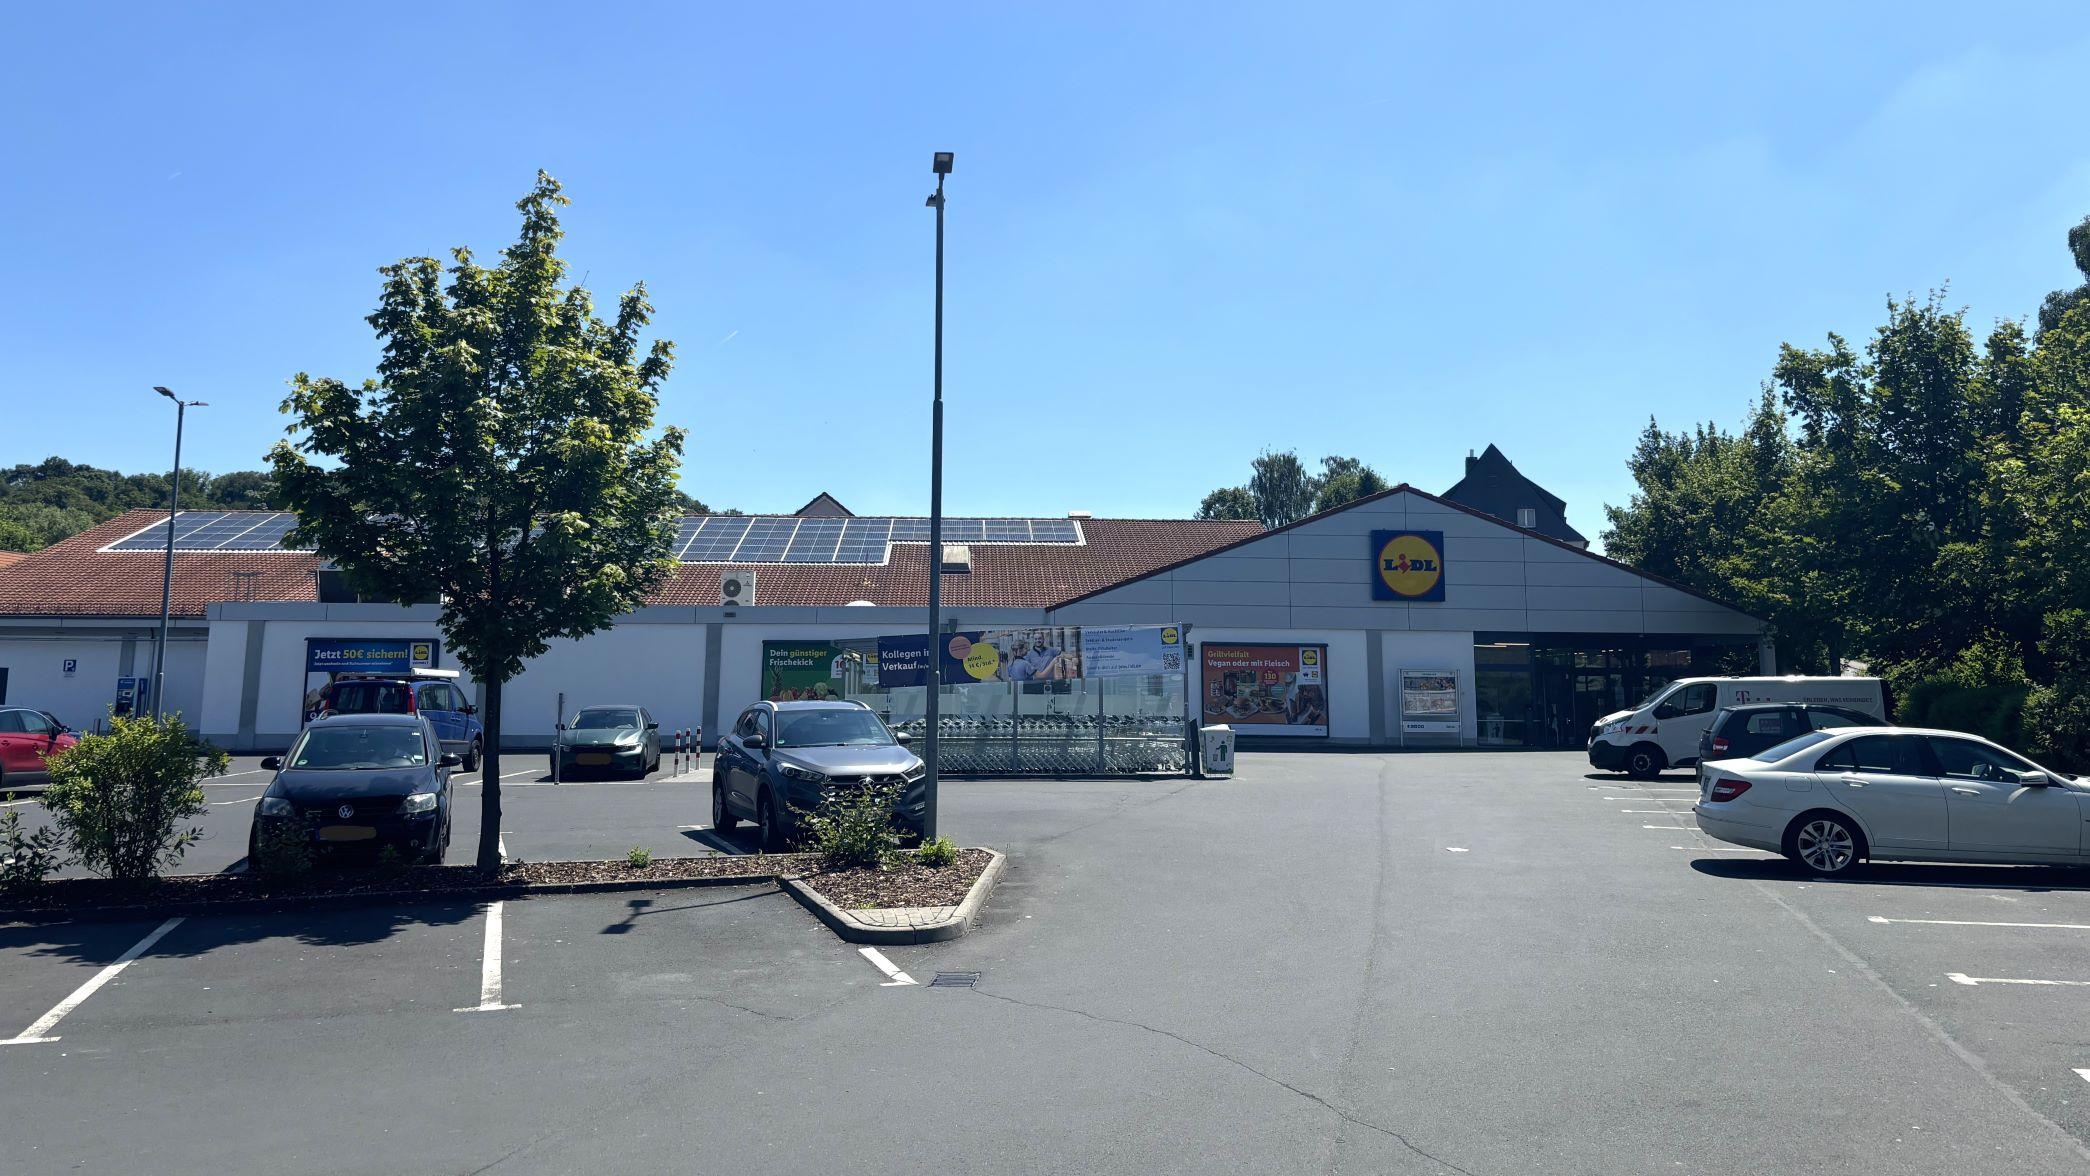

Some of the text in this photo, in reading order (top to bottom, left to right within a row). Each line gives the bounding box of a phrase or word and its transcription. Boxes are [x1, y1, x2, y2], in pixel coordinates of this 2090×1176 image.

[1383, 553, 1437, 573] LIDL
[314, 649, 408, 659] Jetzt 50€ sichern!
[770, 649, 827, 659] Dein günstiger
[882, 650, 922, 660] Kollegen
[1207, 650, 1250, 658] Grillvielfalt
[64, 660, 74, 671] P
[769, 658, 814, 666] Frischekick
[882, 661, 917, 671] Verkauf
[1207, 659, 1290, 668] Vegan oder mit Fleisch
